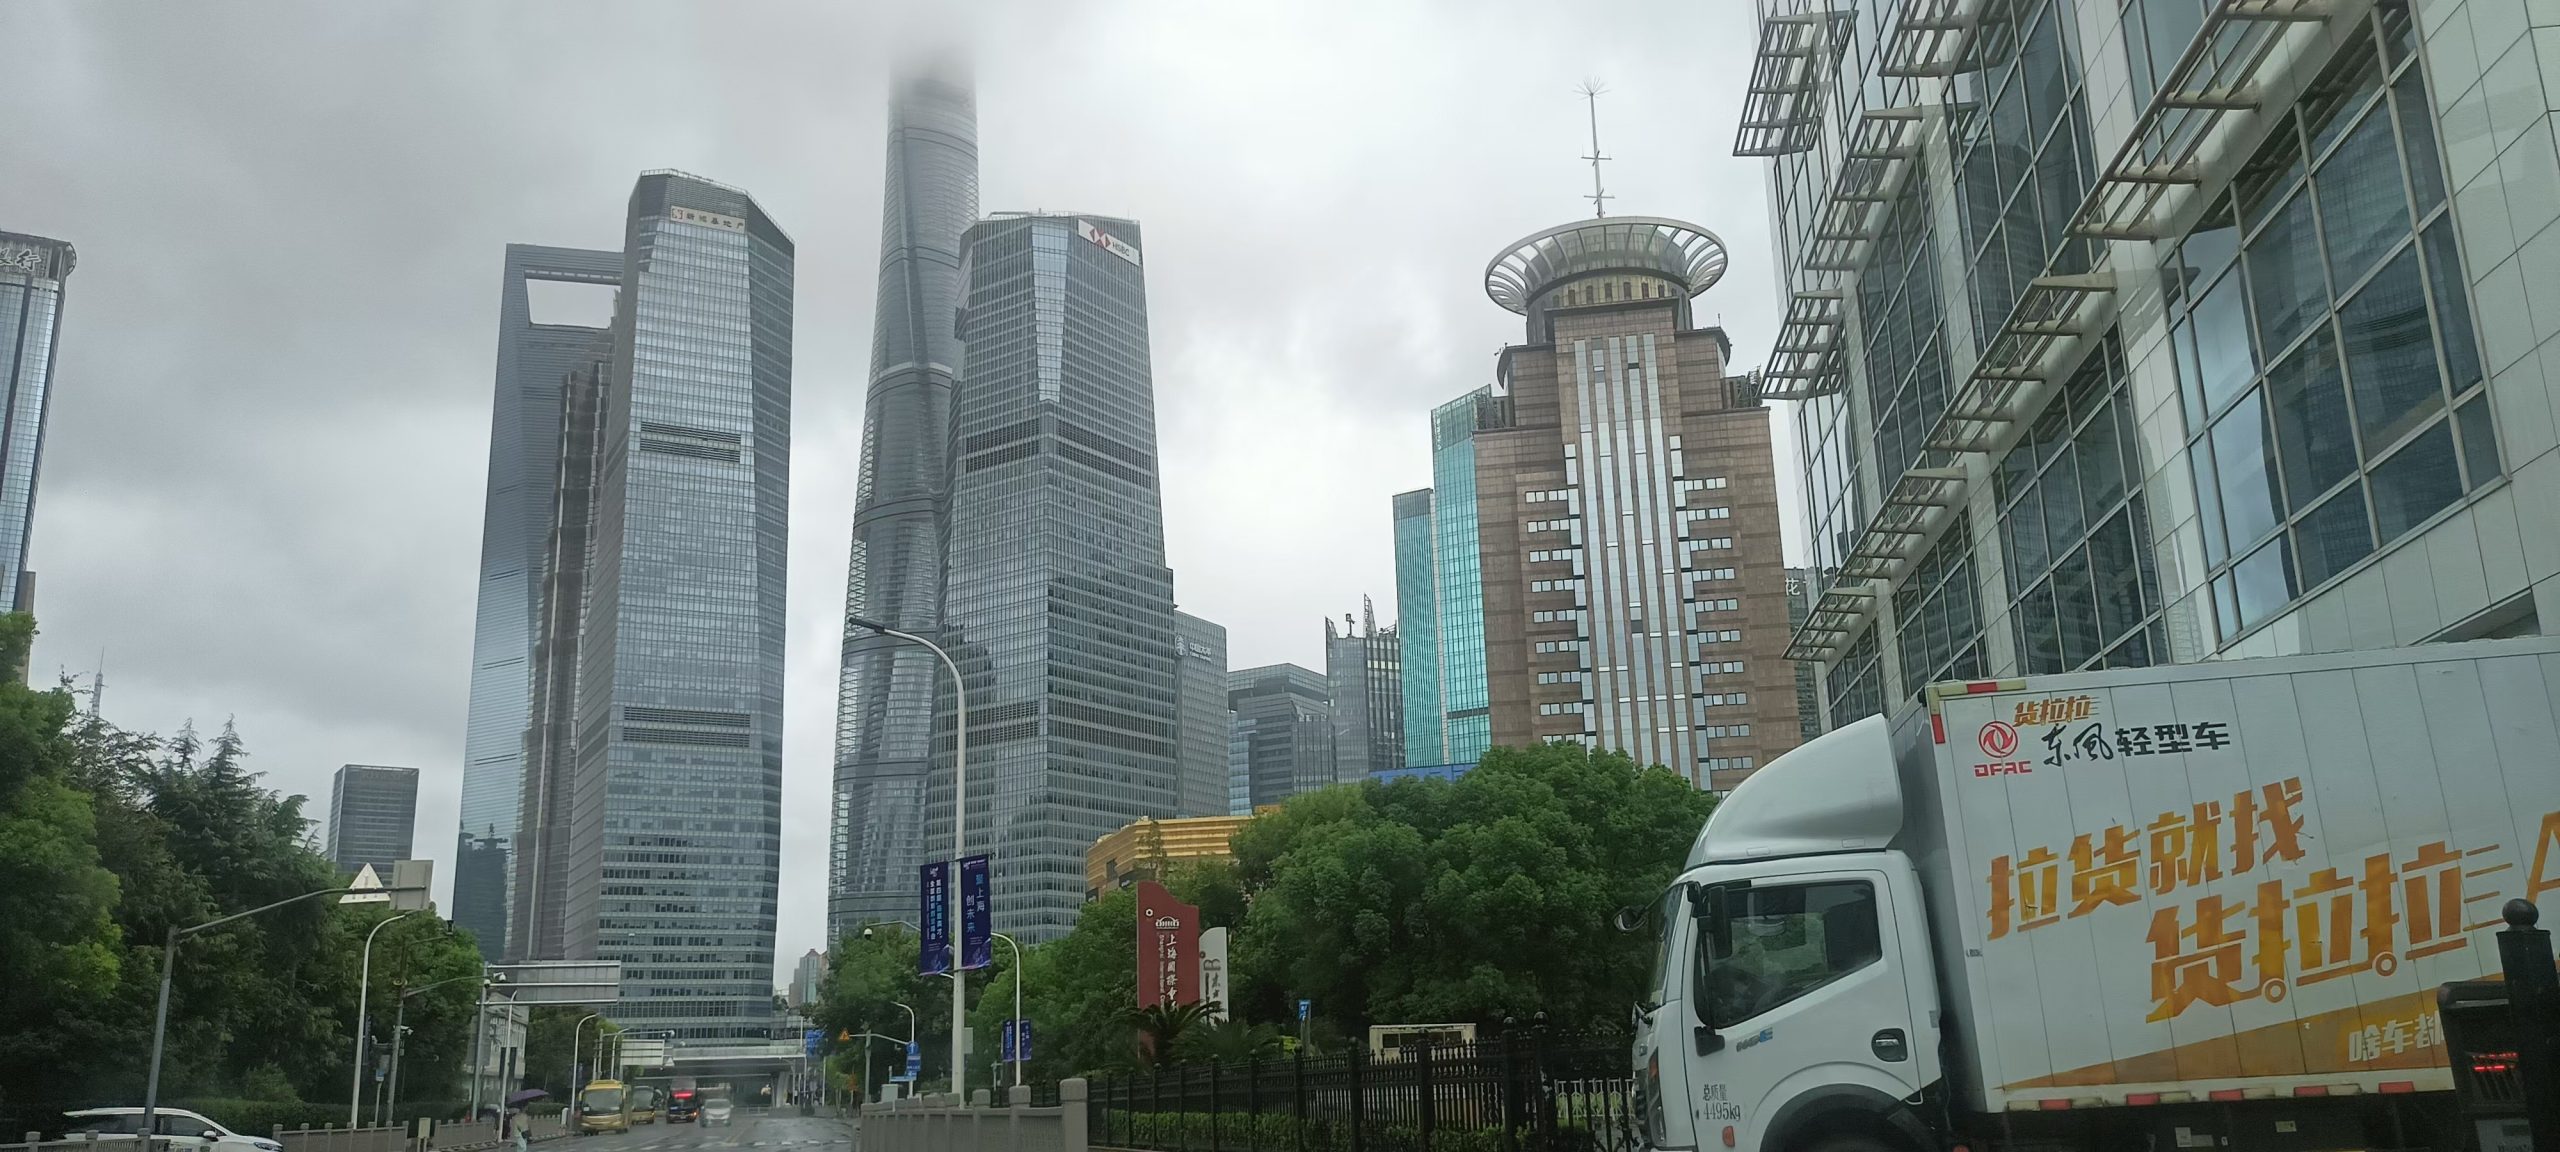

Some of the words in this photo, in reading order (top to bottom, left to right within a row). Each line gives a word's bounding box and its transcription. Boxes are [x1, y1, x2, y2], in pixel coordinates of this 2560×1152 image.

[1785, 577, 1807, 596] 花
[2013, 694, 2096, 727] 货拉拉
[1974, 760, 2033, 778] DFAC
[1986, 776, 2307, 942] 拉货就找
[2145, 840, 2470, 1025] 货拉拉
[1703, 1083, 1728, 1101] 总质量
[1703, 1102, 1741, 1122] 4495kg
